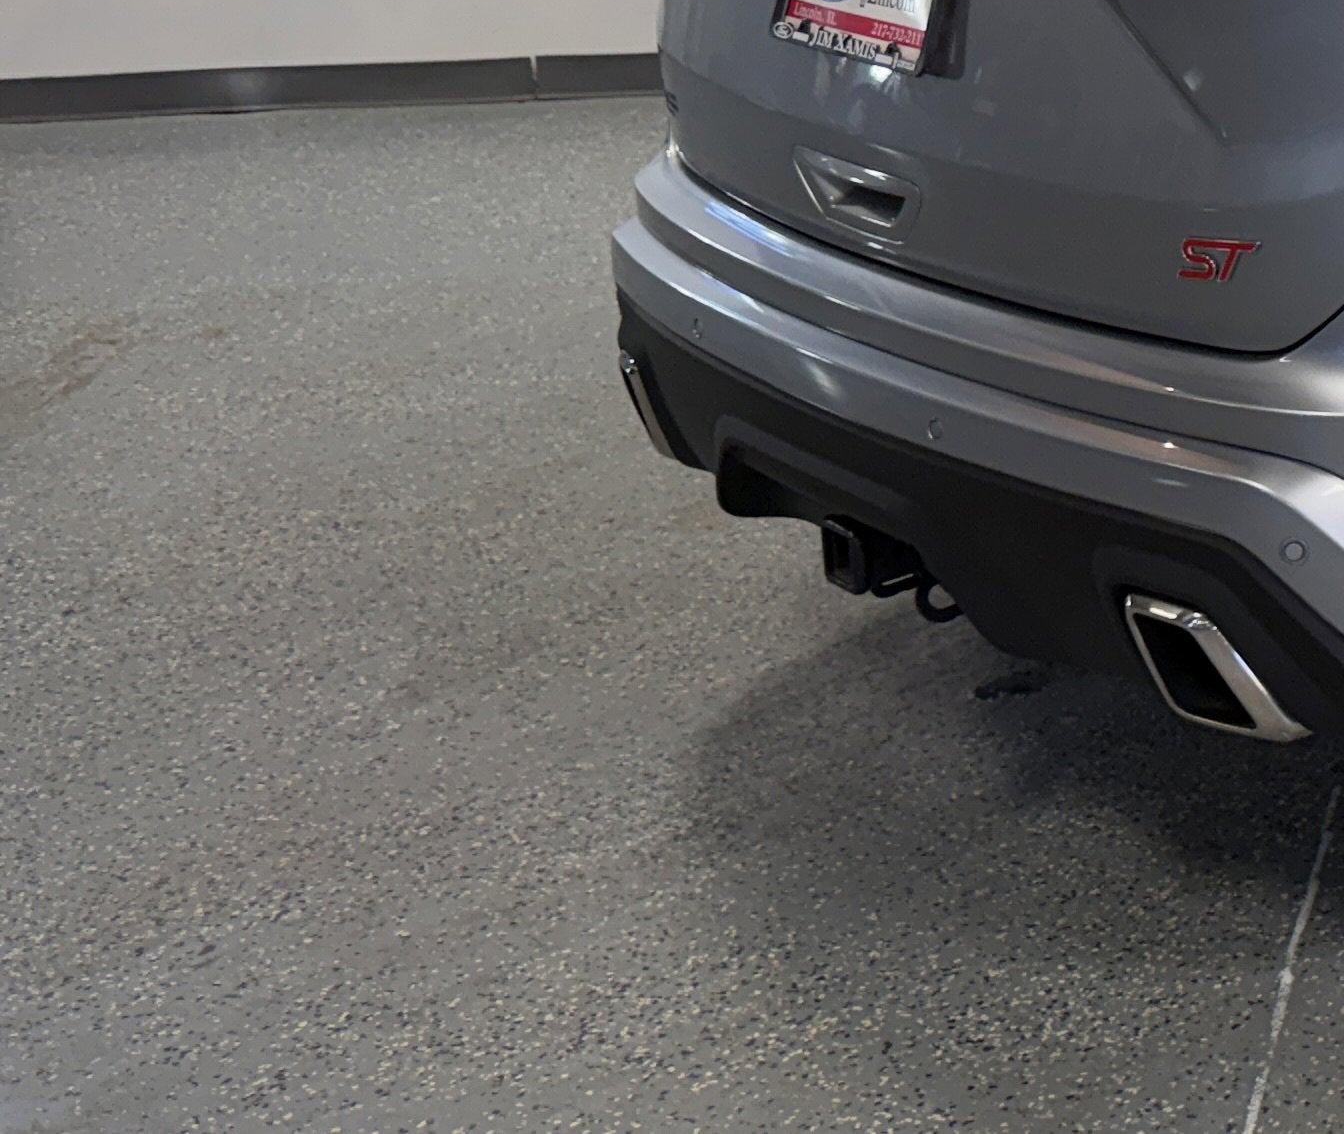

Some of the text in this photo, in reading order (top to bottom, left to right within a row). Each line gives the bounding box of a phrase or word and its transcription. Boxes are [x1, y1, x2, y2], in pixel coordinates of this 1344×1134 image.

[809, 28, 833, 48] JIM
[834, 33, 876, 60] XAMIS
[1177, 237, 1261, 282] ST
